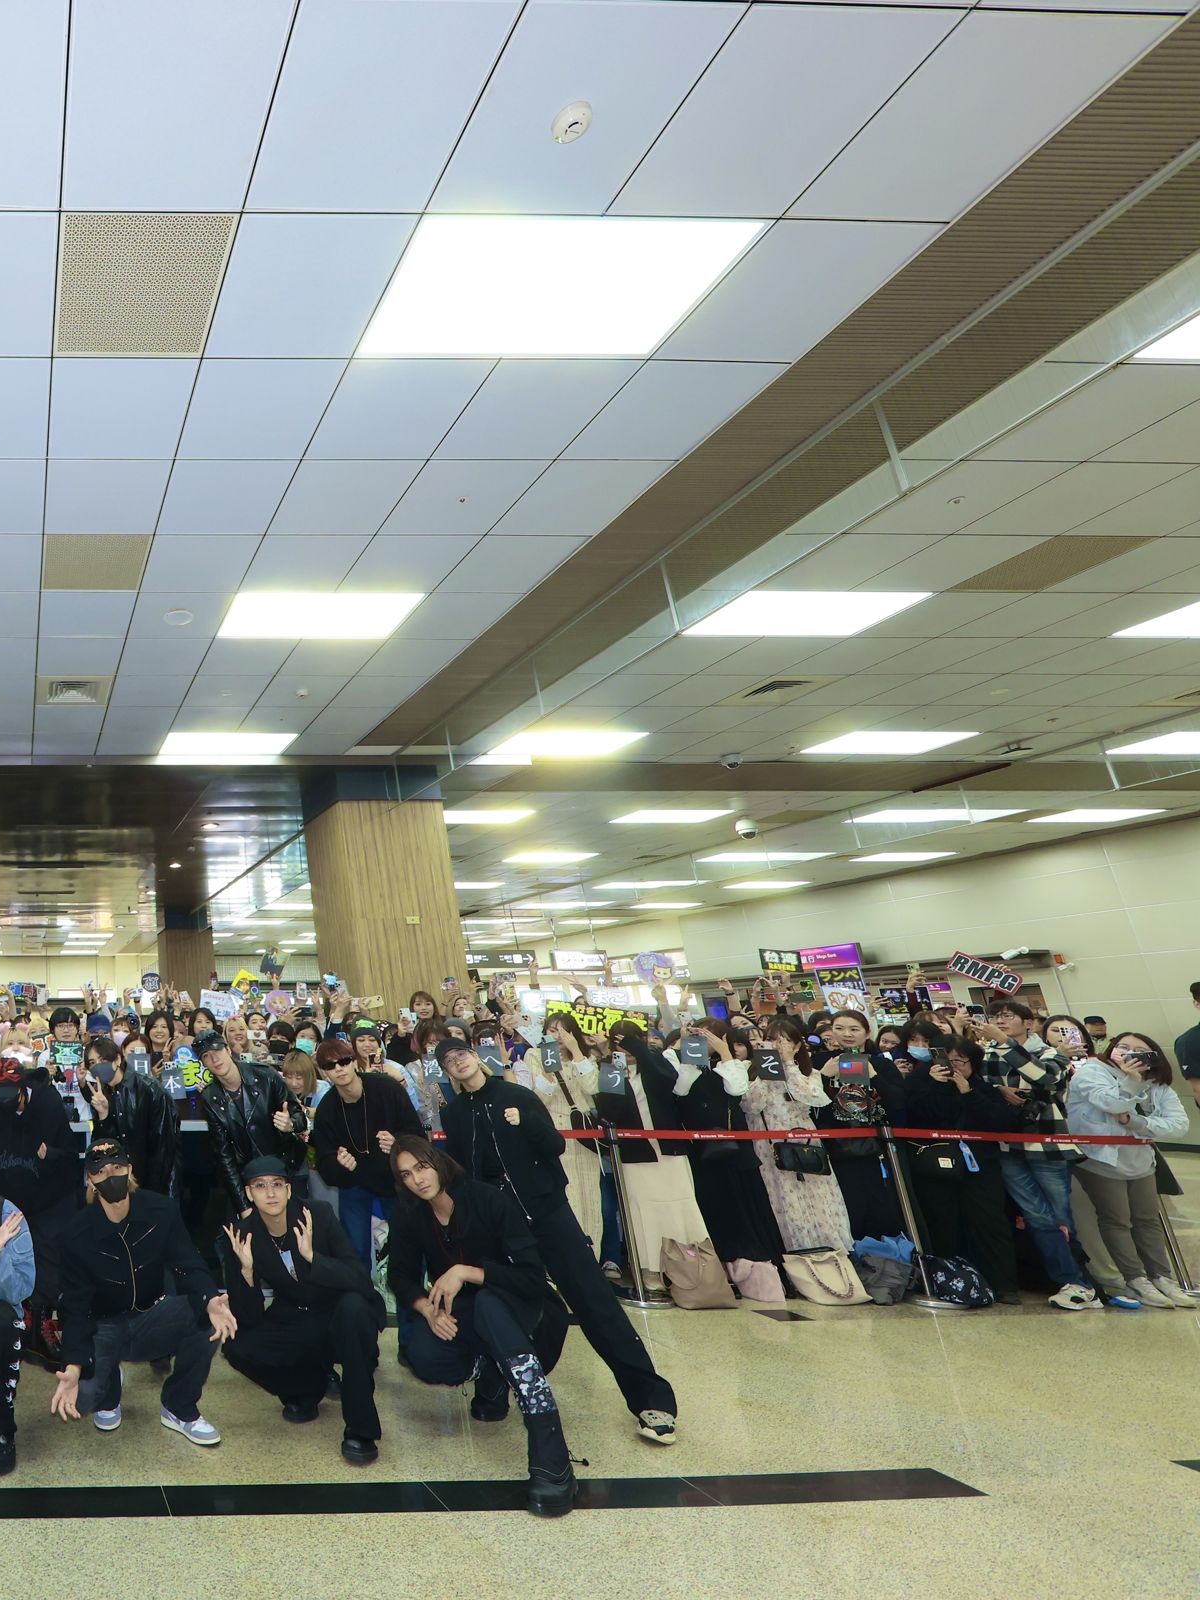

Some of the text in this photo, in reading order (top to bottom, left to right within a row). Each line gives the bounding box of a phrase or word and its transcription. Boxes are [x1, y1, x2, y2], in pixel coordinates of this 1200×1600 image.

[819, 969, 859, 982] ランペ
[950, 953, 1019, 992] RMPG
[544, 1049, 557, 1067] よ
[686, 1042, 703, 1058] こ
[761, 1055, 779, 1074] そ
[164, 1075, 182, 1094] 本
[608, 1070, 621, 1088] う
